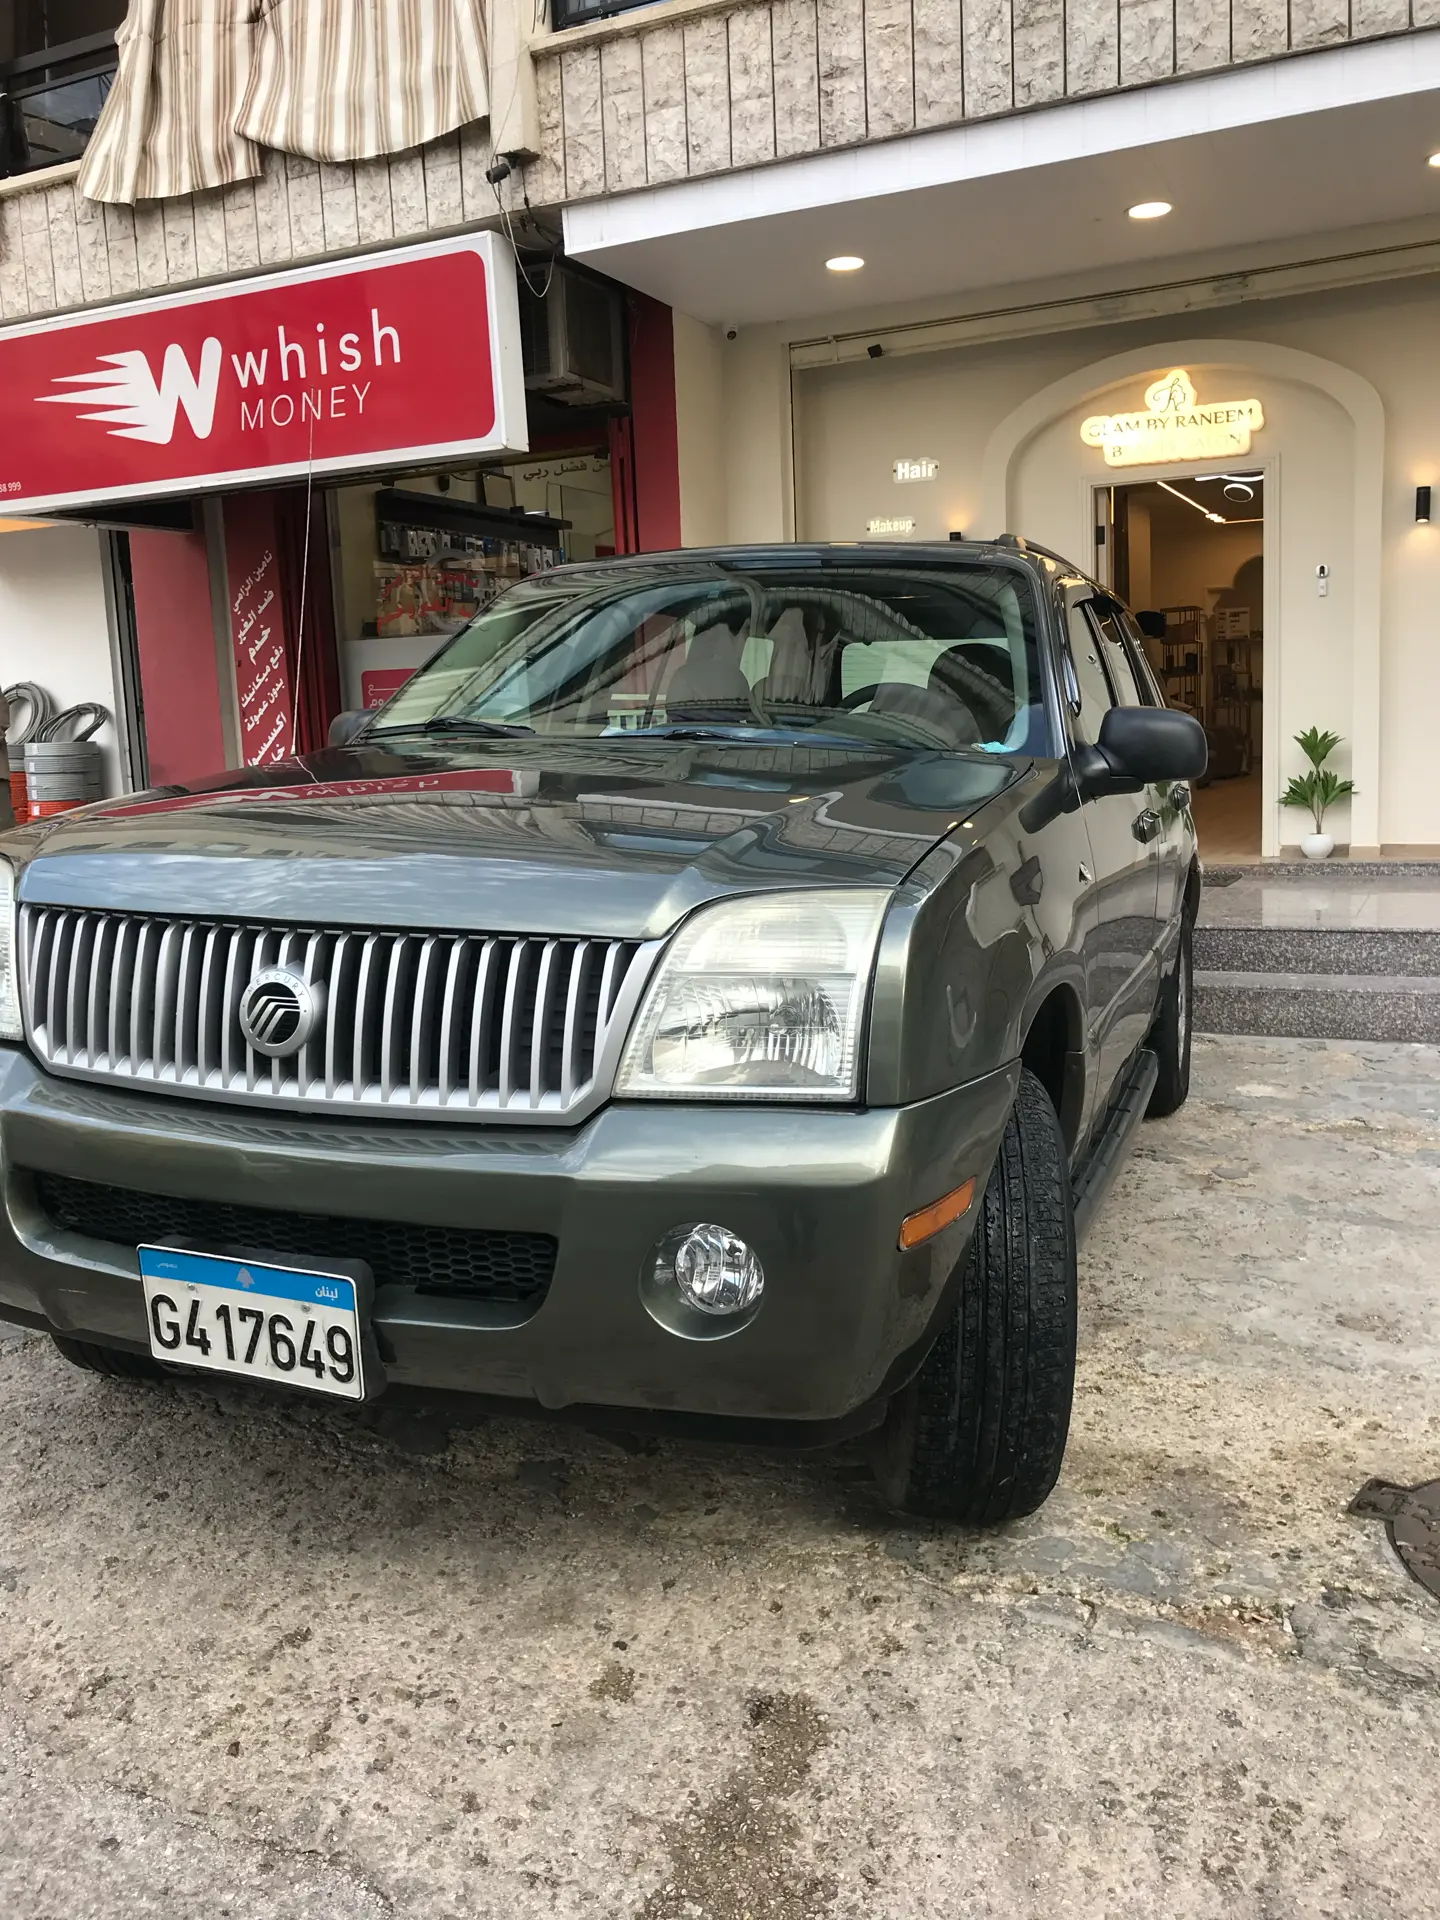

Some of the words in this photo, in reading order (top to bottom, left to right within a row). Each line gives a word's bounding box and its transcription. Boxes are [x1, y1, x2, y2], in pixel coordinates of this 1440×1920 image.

[231, 308, 401, 388] whish
[241, 381, 371, 431] MONEY
[1146, 416, 1171, 430] BY
[1175, 408, 1253, 428] RANEEM
[897, 460, 935, 480] Hair
[8, 481, 21, 492] 999
[870, 519, 913, 533] Makeup
[258, 590, 275, 614] ضد
[247, 973, 305, 997] MERCURY
[315, 1285, 338, 1301] لبنان
[151, 1293, 354, 1383] G417649
